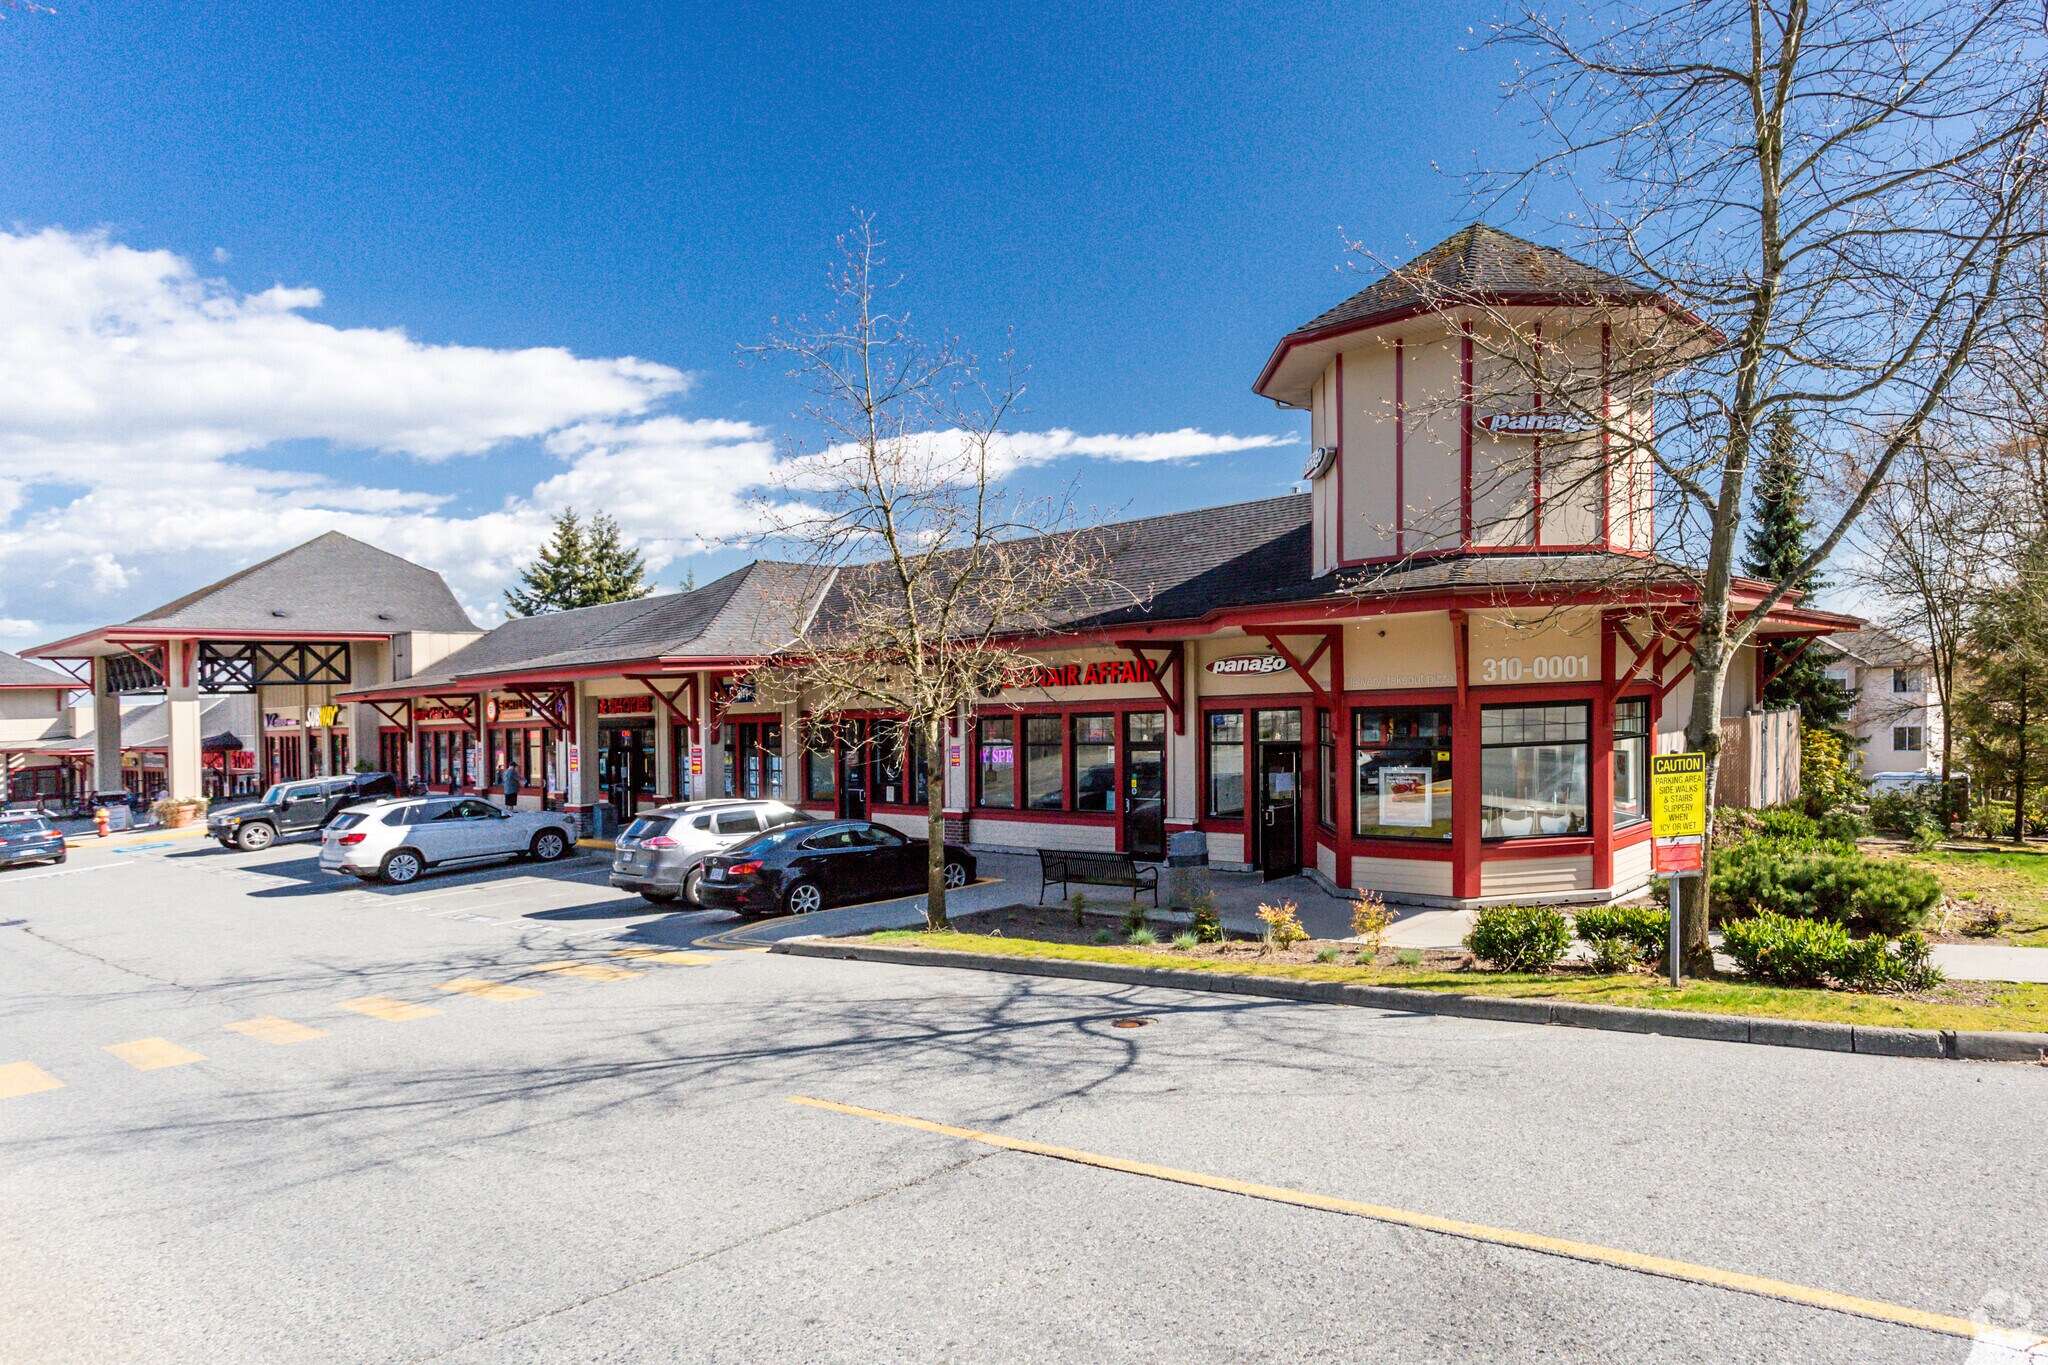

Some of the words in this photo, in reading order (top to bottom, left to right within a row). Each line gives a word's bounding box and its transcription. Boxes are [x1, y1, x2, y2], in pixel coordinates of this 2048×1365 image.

[1212, 656, 1287, 674] panago
[1482, 654, 1589, 682] 310-0001
[305, 706, 339, 728] SUBWAY
[1656, 758, 1700, 772] CAUTION
[1655, 776, 1684, 785] PARKING
[1684, 774, 1702, 783] AREA
[1659, 786, 1674, 795] SIDE
[1675, 784, 1698, 793] WALKS
[1663, 796, 1669, 804] &
[1670, 793, 1694, 803] STAIRS
[1663, 803, 1694, 813] SLIPPERY
[1668, 813, 1688, 822] WHEN
[1660, 823, 1671, 832] ICY
[1672, 822, 1682, 831] OR
[1682, 821, 1697, 831] WET
